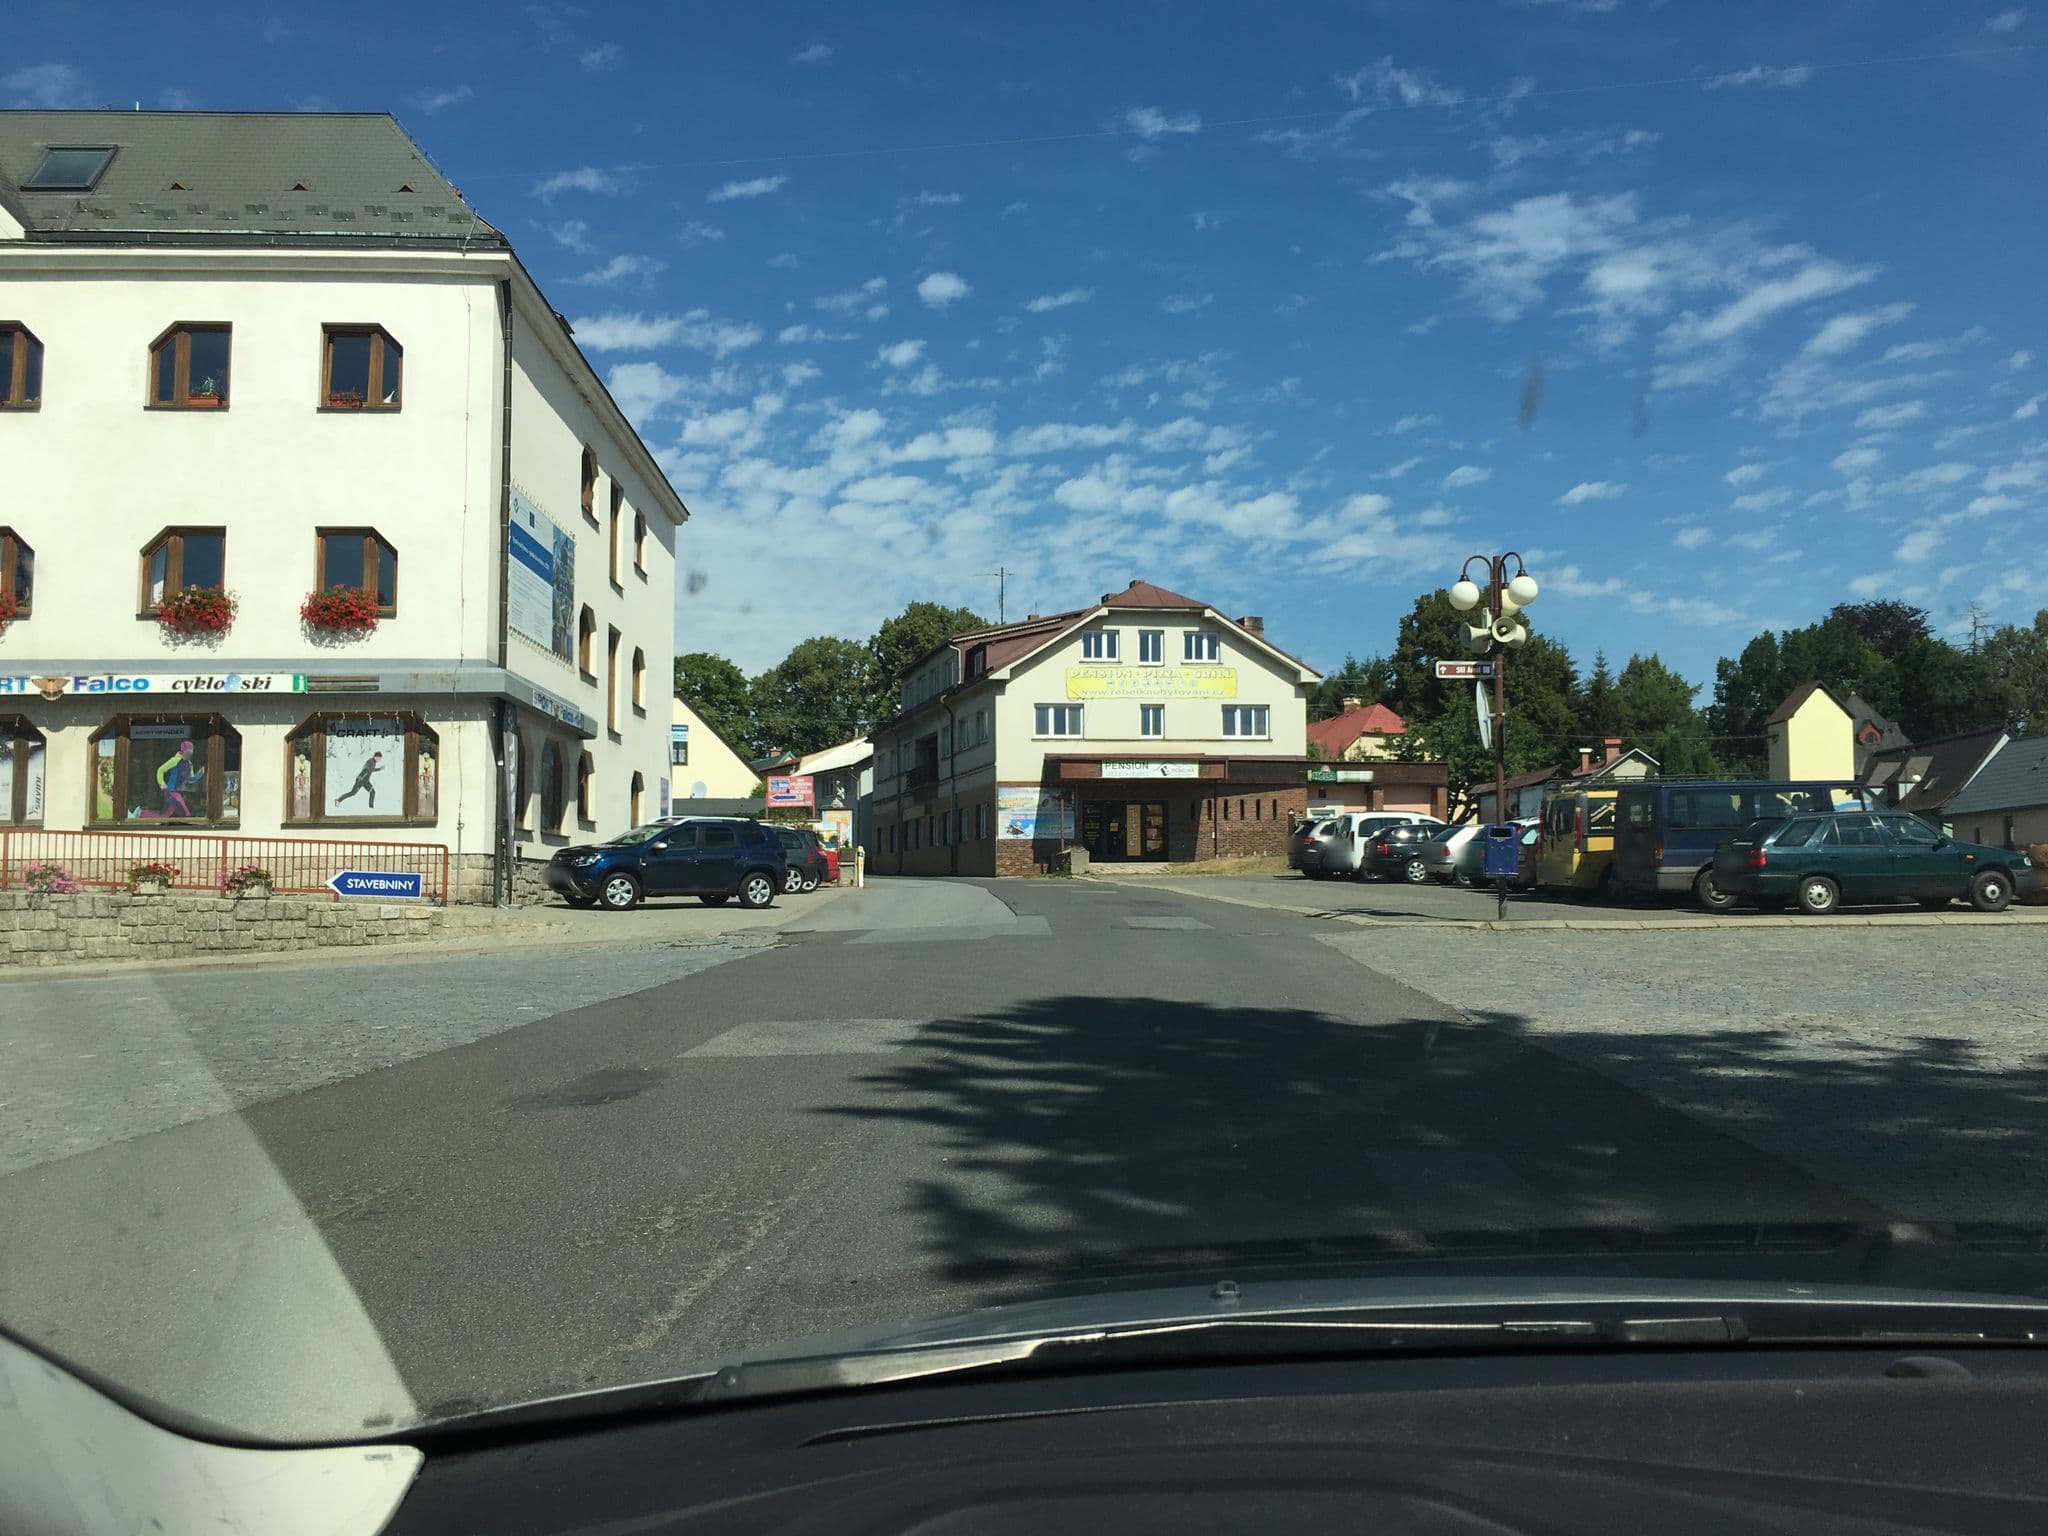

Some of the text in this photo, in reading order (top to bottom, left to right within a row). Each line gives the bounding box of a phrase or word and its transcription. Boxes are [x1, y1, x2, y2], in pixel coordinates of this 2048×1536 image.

[73, 675, 150, 691] Falco
[171, 676, 225, 694] cyklo
[240, 676, 272, 691] ski
[336, 729, 380, 738] CRAFT
[1105, 761, 1149, 770] PENSION
[346, 878, 415, 890] STAVEBNINY
